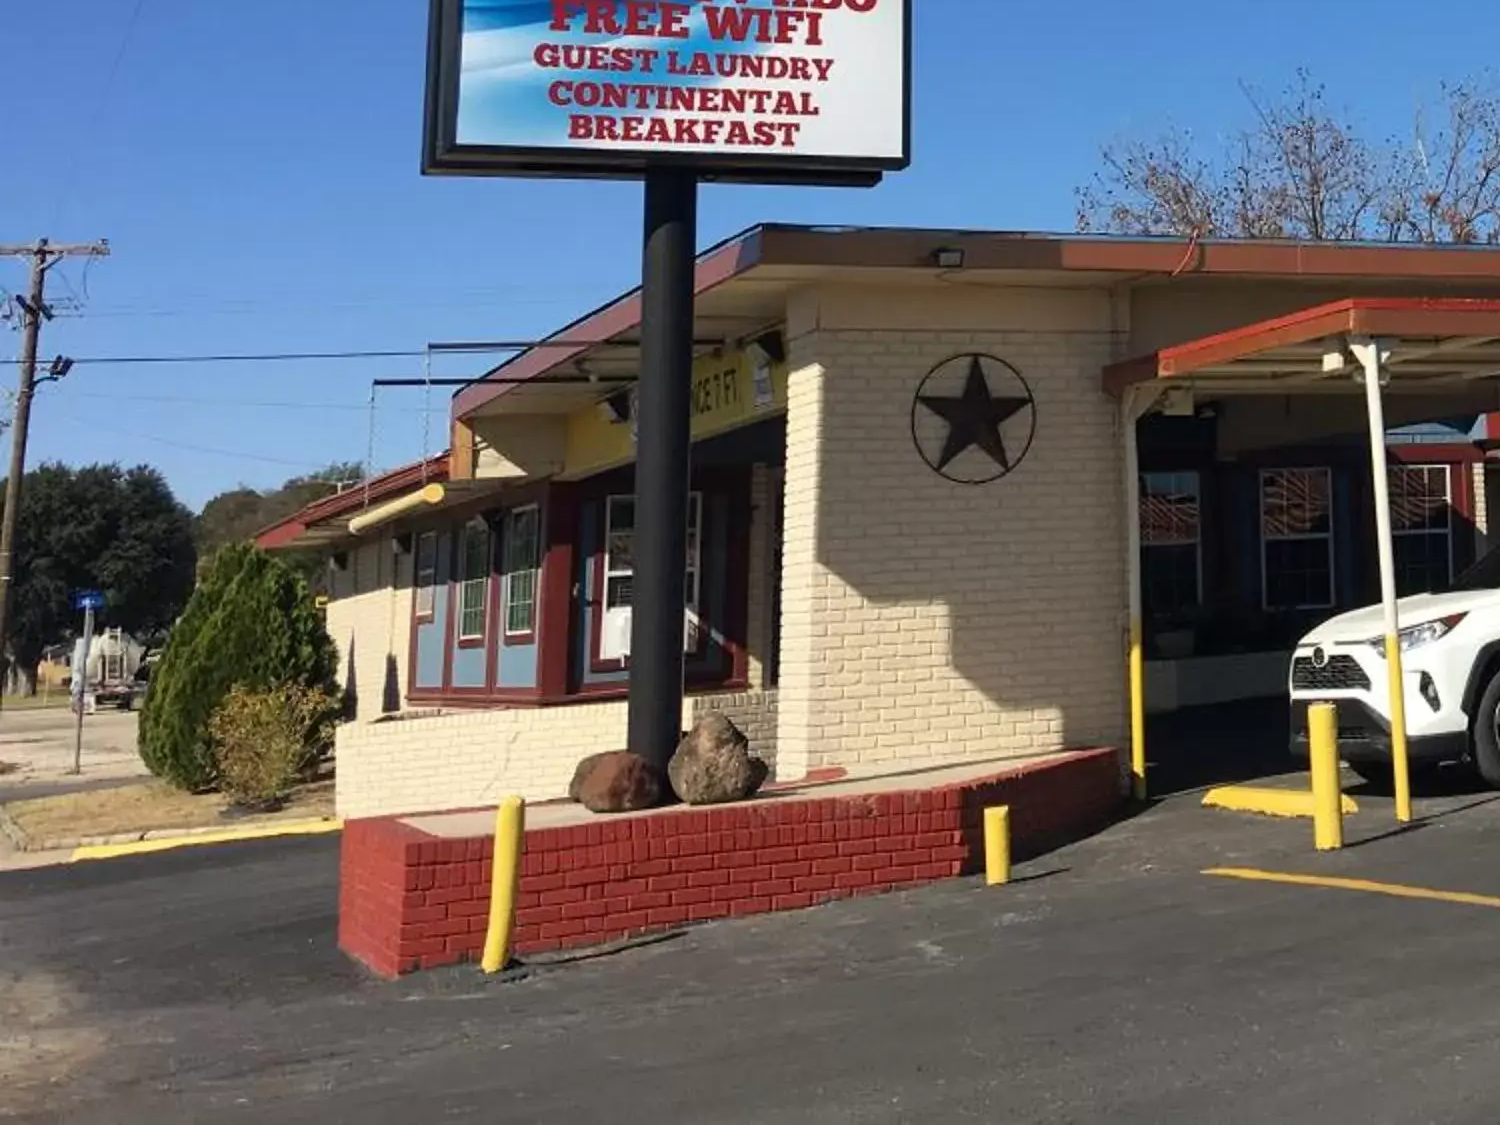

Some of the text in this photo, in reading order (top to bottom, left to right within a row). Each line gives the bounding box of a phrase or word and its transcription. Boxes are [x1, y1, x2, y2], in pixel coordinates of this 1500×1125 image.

[703, 6, 823, 46] WIFI
[533, 43, 834, 82] GUEST LAUNDRY
[547, 80, 819, 116] CONTINENTAL
[568, 114, 800, 147] BREAKFAST
